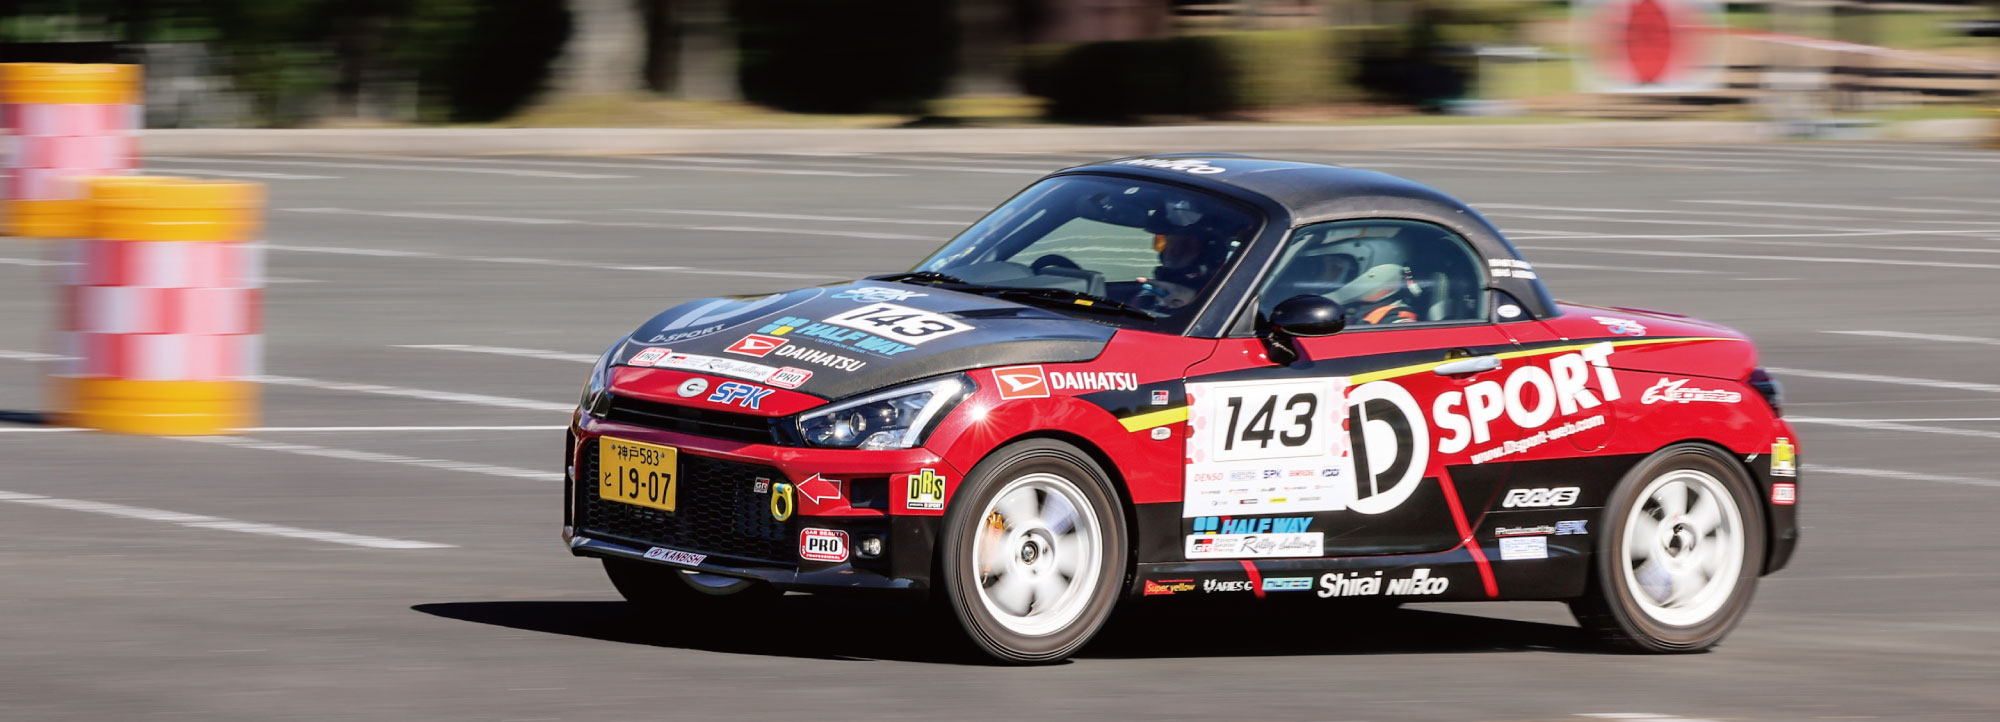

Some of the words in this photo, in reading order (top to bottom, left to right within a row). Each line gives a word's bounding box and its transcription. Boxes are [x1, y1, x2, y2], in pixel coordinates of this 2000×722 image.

[649, 324, 726, 343] D-SPORT
[842, 307, 955, 336] 143
[795, 322, 868, 342] HALF
[854, 336, 916, 355] WAY
[775, 344, 867, 372] DAIHATSU
[776, 372, 800, 382] PRO
[1050, 372, 1138, 391] DAIHATSU
[707, 381, 776, 410] SPK
[1432, 341, 1621, 454] SPORT
[1224, 393, 1318, 451] 143
[619, 466, 671, 504] 19-07
[910, 470, 943, 500] DRS
[1194, 473, 1224, 482] DENSO
[1502, 486, 1581, 508] RAYS
[1221, 518, 1272, 534] HALF
[1271, 517, 1314, 533] WAY
[809, 538, 838, 552] PRO
[1147, 584, 1169, 593] Super
[1169, 583, 1196, 593] yellow
[1317, 570, 1384, 598] Shirai
